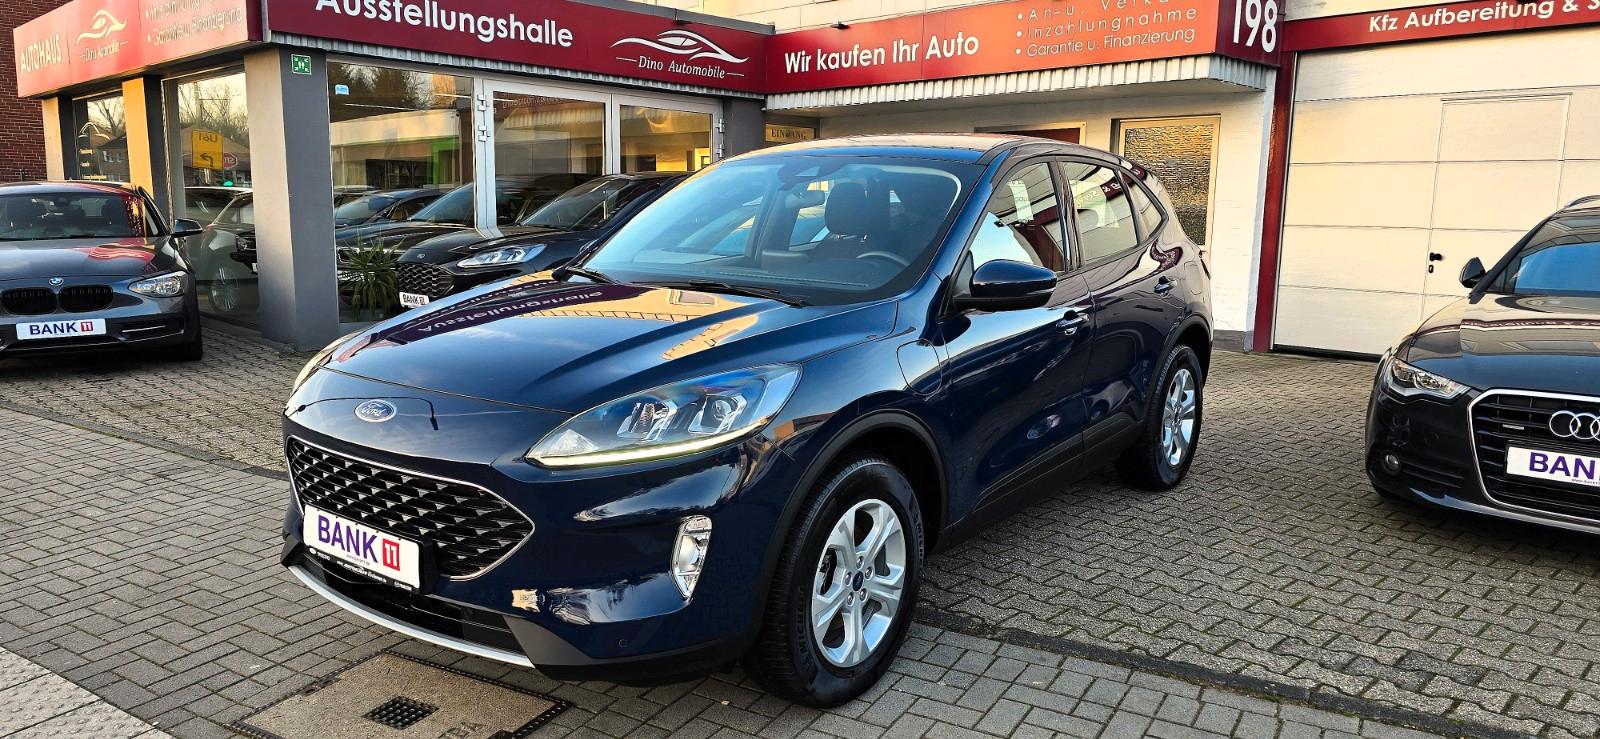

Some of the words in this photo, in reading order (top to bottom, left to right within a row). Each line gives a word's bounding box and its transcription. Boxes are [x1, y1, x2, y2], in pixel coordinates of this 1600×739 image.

[1028, 8, 1197, 39] Inzahlungnahme
[1233, 0, 1278, 53] 198
[1369, 13, 1398, 33] Kfz
[1404, 0, 1554, 29] Aufbereitung
[1562, 0, 1579, 13] &
[20, 33, 62, 73] AUTOHAUS
[785, 48, 812, 74] Wir
[817, 44, 887, 71] kaufen
[892, 39, 921, 64] Ihr
[925, 32, 980, 60] Auto
[1026, 38, 1083, 58] Garantie
[1087, 40, 1099, 51] u.
[1103, 27, 1196, 49] Finanzierung
[638, 54, 664, 71] Dino
[668, 59, 726, 79] Automobile
[29, 321, 78, 336] BANK
[81, 321, 93, 332] 11
[360, 402, 386, 417] Ford
[1528, 451, 1600, 482] BAN
[317, 514, 379, 564] BANK
[384, 541, 400, 570] 11
